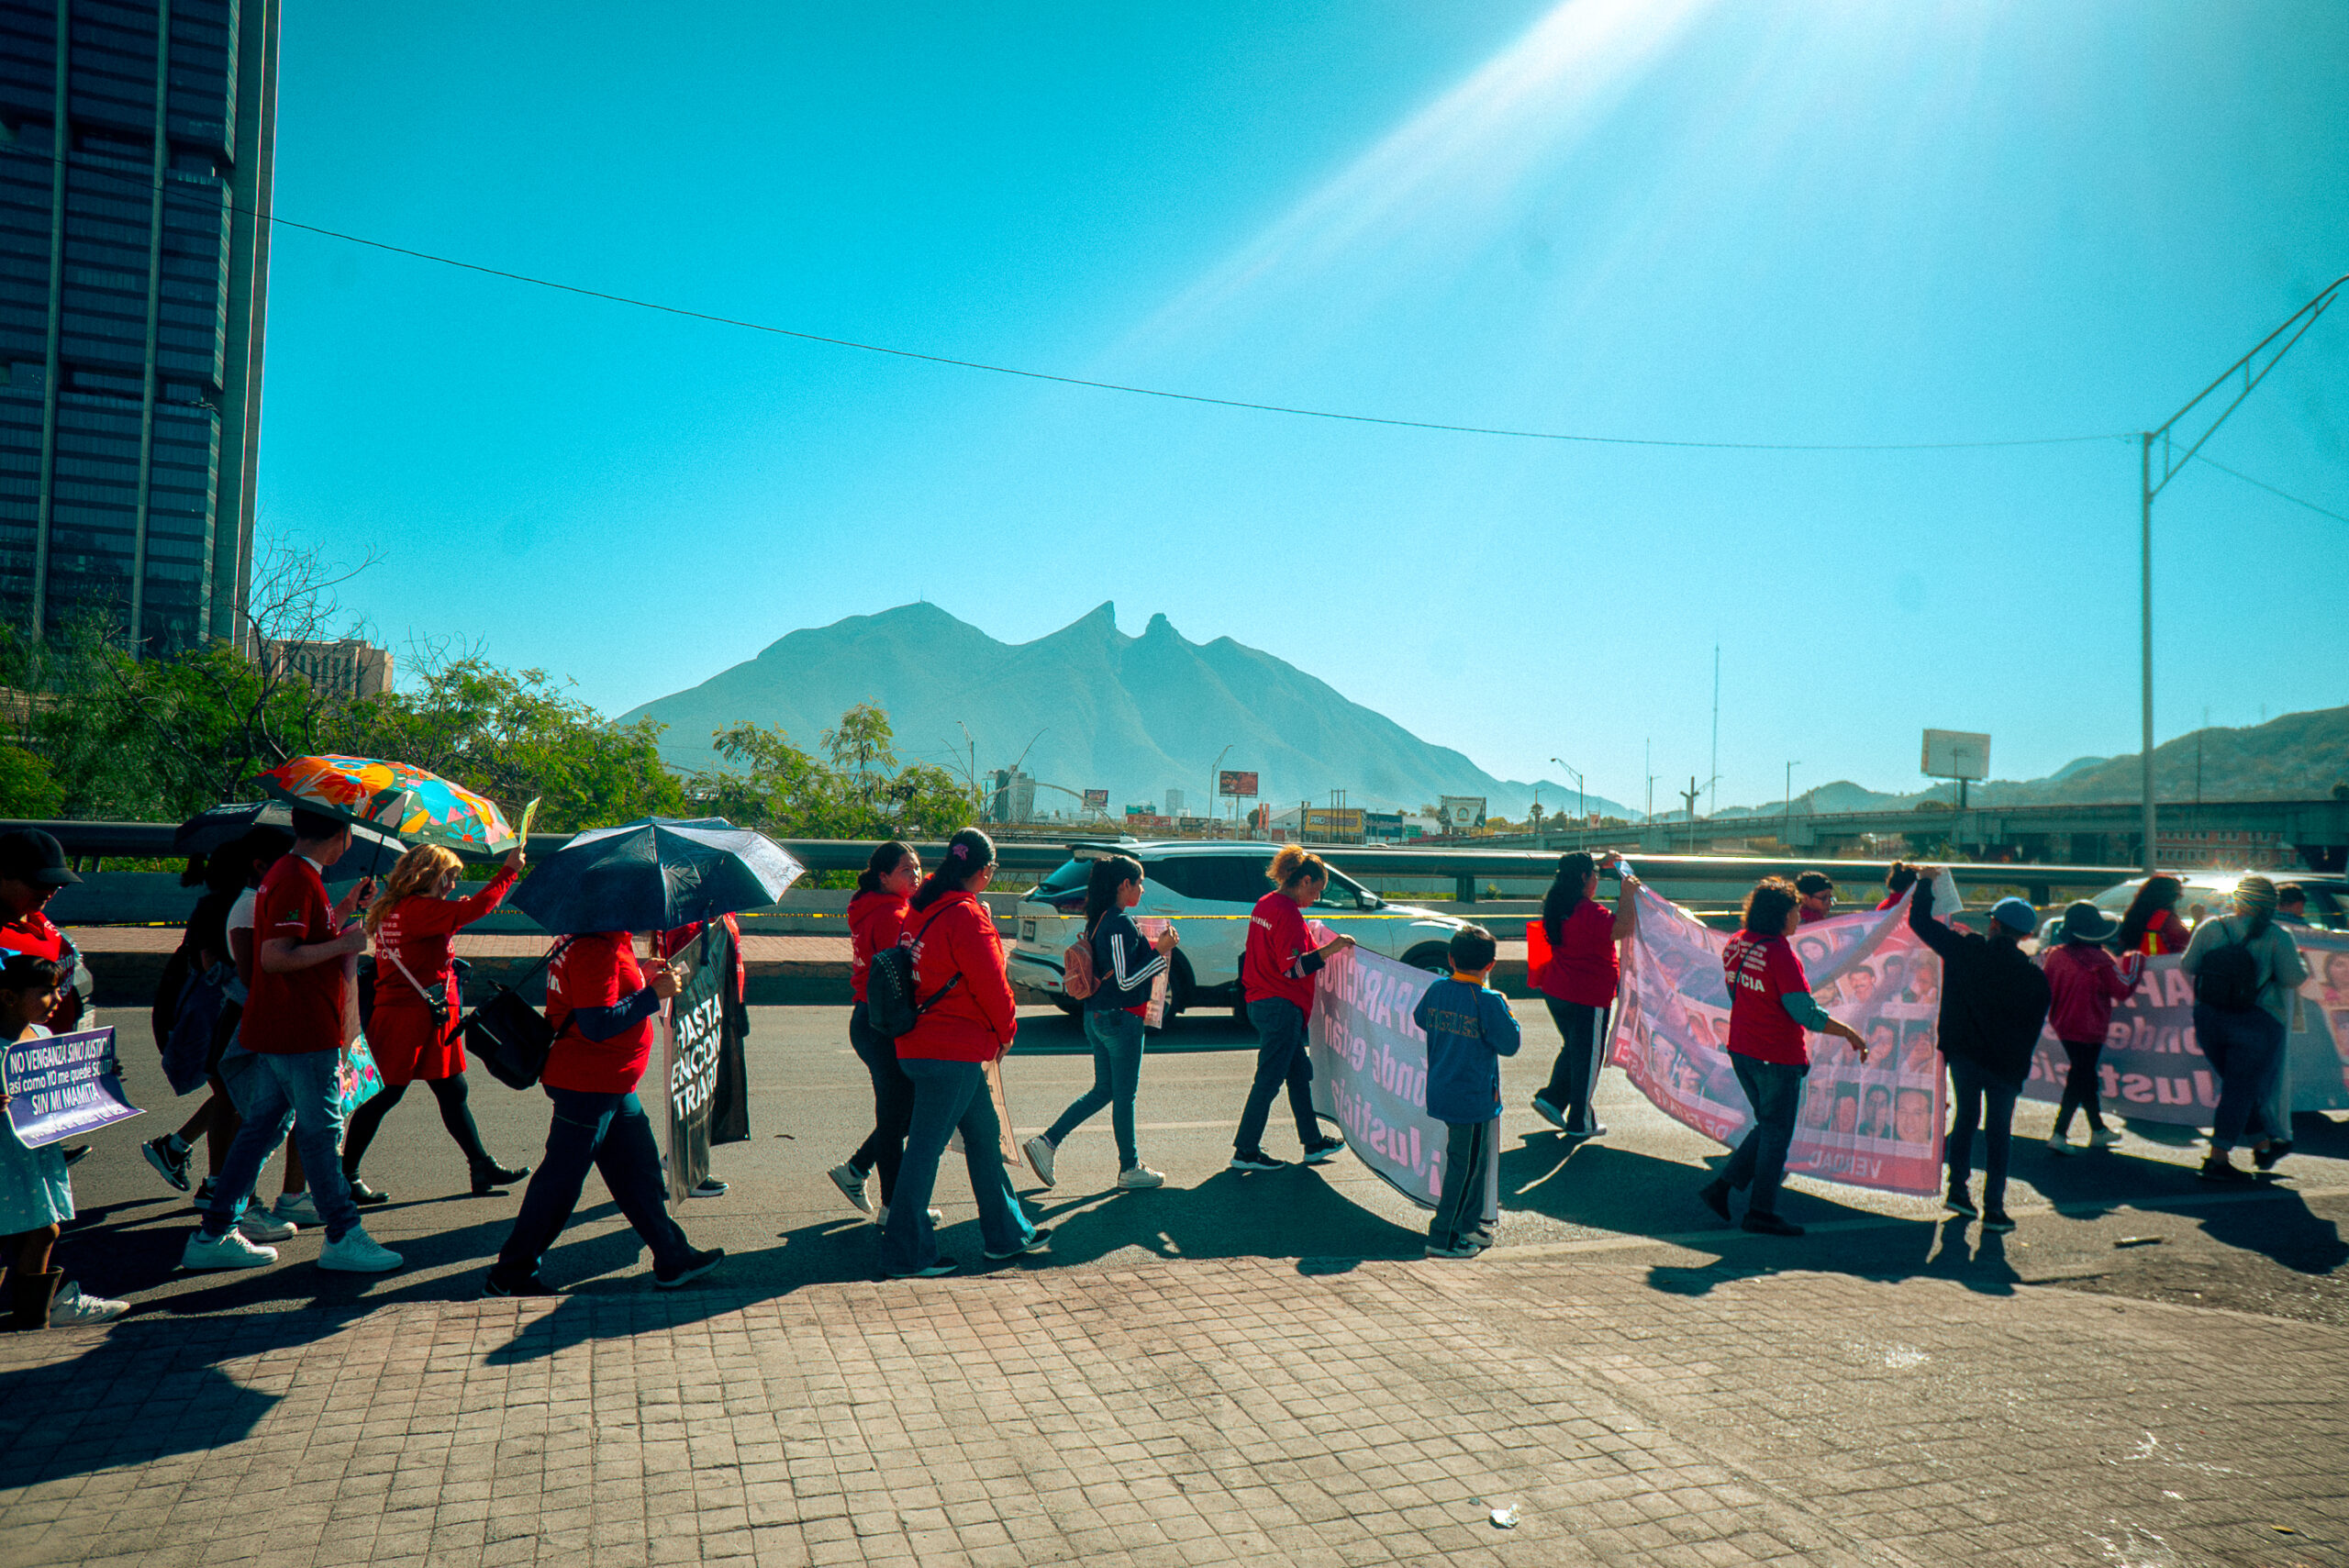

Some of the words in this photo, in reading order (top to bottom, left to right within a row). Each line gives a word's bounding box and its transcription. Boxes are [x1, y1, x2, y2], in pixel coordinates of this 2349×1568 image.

[676, 993, 723, 1054] HASTA
[9, 1052, 25, 1074] NO
[26, 1042, 67, 1072] VENGANZA
[68, 1040, 84, 1064] SINO
[84, 1037, 111, 1061] JUSTICIA
[8, 1076, 22, 1095] así
[23, 1076, 46, 1092] como
[46, 1070, 57, 1086] YO
[58, 1071, 70, 1084] me
[71, 1062, 92, 1084] quedé
[31, 1092, 50, 1116] SIN
[50, 1089, 62, 1112] MI
[63, 1081, 102, 1107] MAMITA
